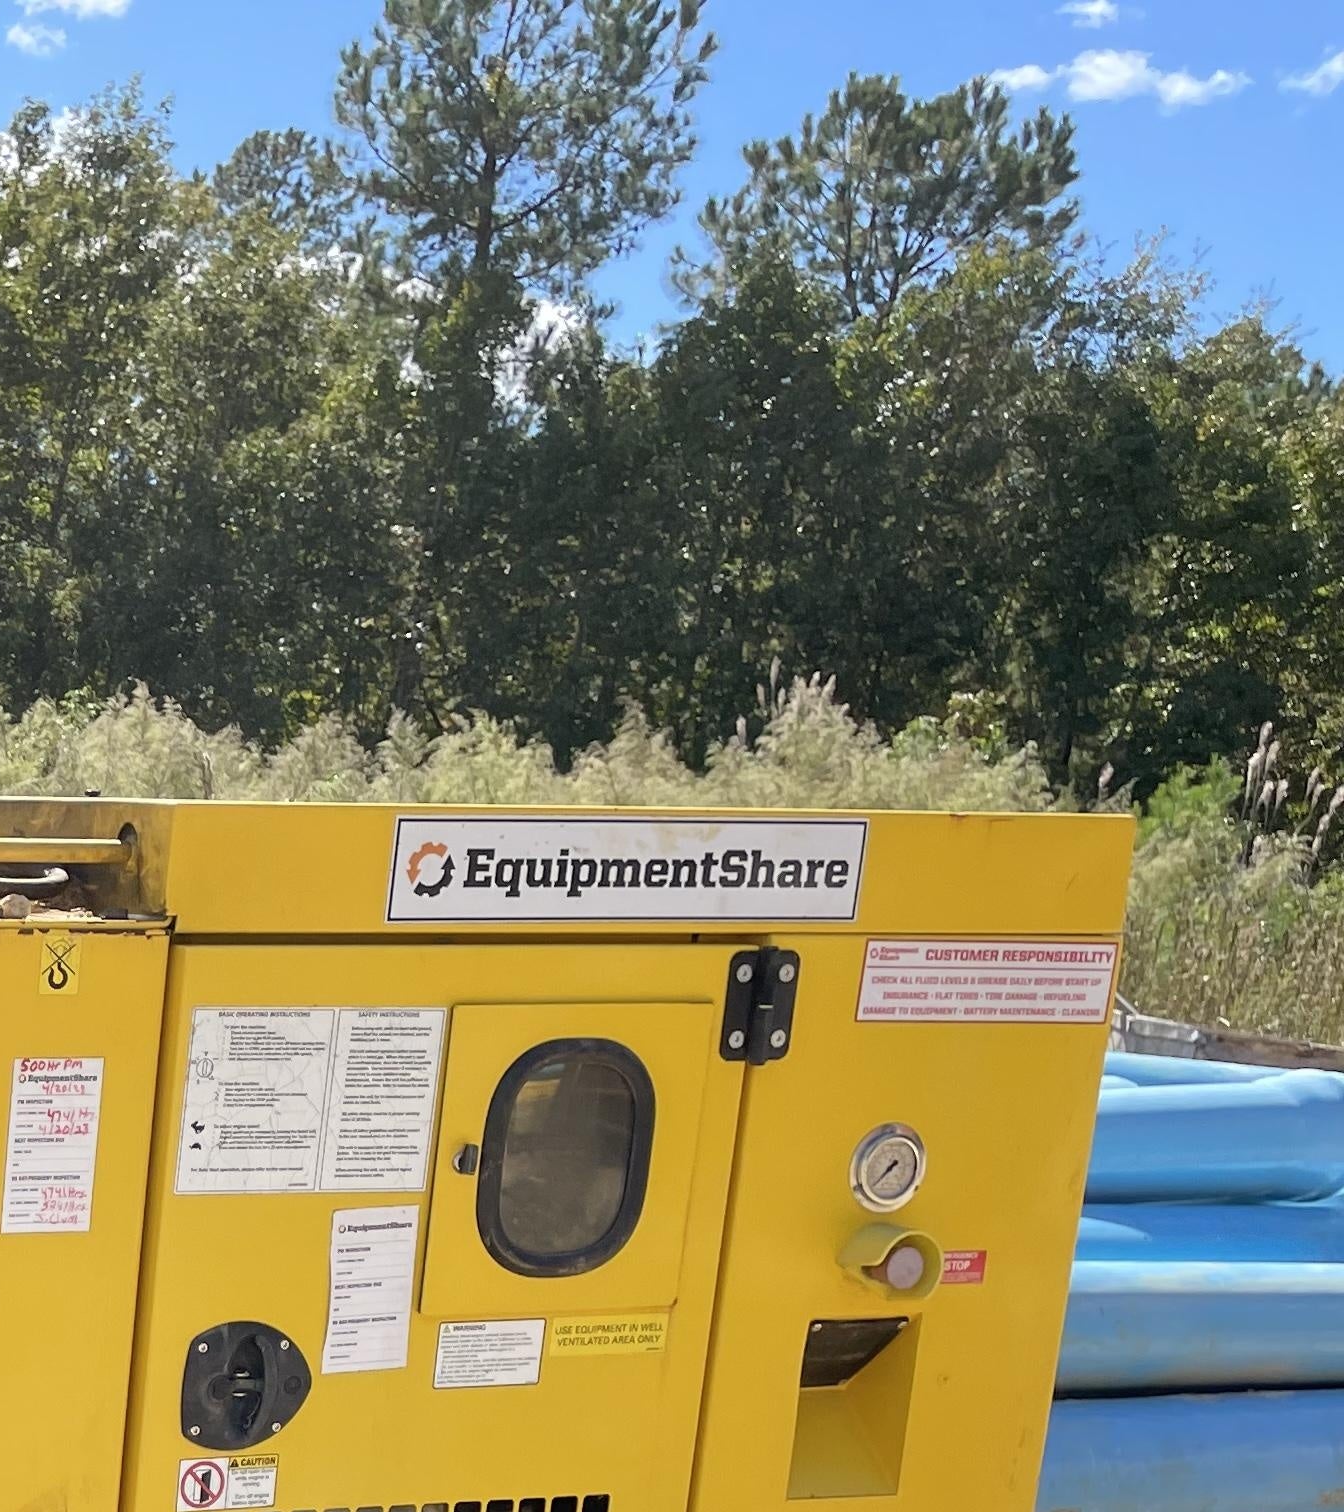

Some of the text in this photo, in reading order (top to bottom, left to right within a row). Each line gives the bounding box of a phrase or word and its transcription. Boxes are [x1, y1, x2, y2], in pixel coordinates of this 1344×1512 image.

[463, 848, 849, 898] EquipmentShare
[926, 949, 999, 961] CUSTOMER
[1002, 950, 1113, 963] RESPONSIBILITY
[872, 976, 898, 984] CHECK
[900, 976, 912, 984] ALL
[977, 977, 1008, 985] GREASE
[1010, 977, 1032, 985] DAILY
[1005, 992, 1037, 1000] DAMAGE
[911, 1007, 957, 1015] EQUIPMENT
[964, 1007, 997, 1015] BATTERY
[20, 1058, 46, 1072] 500
[28, 1074, 97, 1084] EquipmentShare
[944, 1260, 971, 1271] STOP
[555, 1323, 663, 1335] USE EQUIPMENT IN WELL
[557, 1335, 661, 1346] VENTILATED AREA ONLY
[240, 1457, 276, 1466] CAUTION
